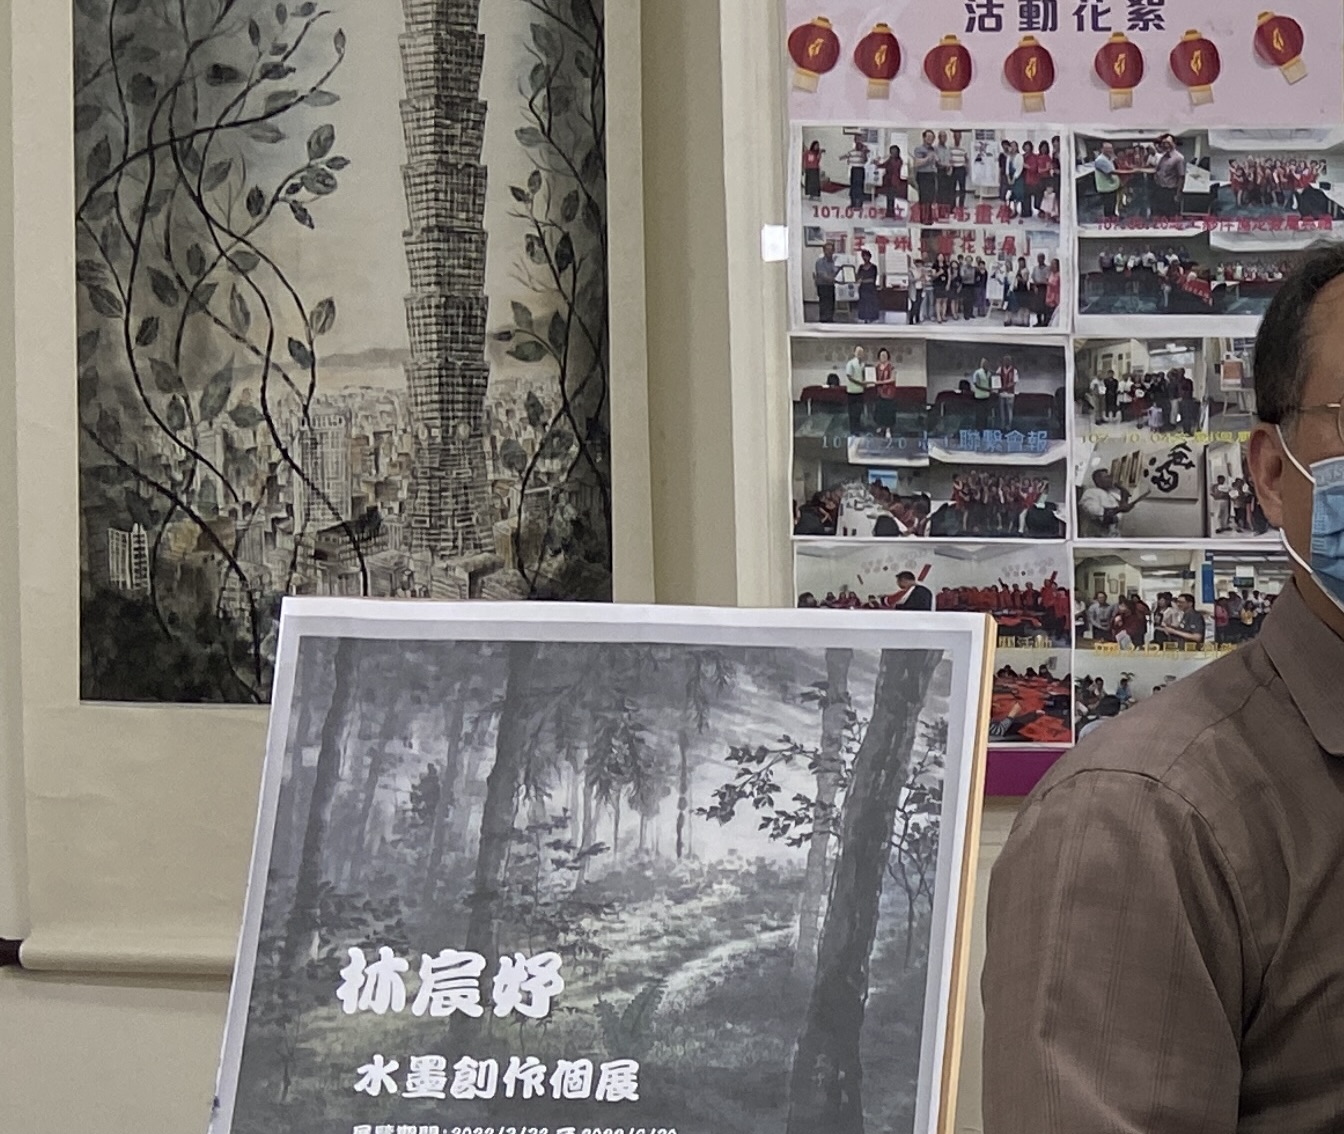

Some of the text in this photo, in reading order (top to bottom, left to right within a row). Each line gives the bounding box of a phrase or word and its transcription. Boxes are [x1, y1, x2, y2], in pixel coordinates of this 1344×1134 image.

[965, 0, 1166, 32] 活動花絮
[338, 947, 564, 1018] 林宸妤
[353, 1056, 641, 1102] 水墨創作個展
